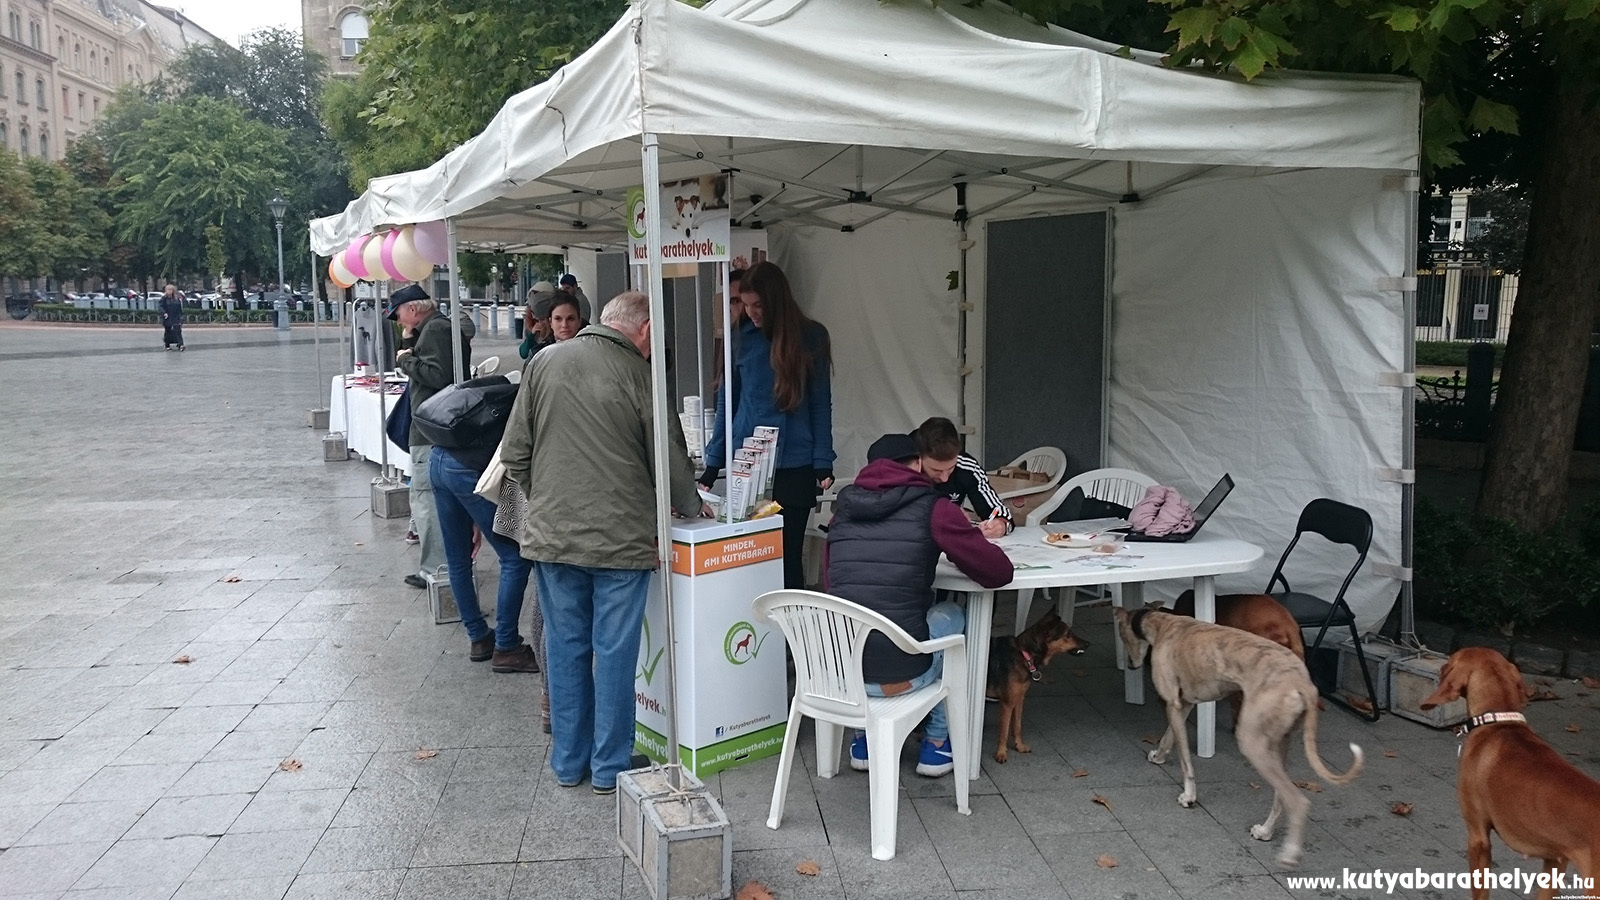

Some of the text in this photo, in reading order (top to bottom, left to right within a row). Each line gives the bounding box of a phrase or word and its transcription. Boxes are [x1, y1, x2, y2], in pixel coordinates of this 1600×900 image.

[634, 238, 725, 260] kutarathelyek.hu
[704, 545, 775, 568] AMI KUTYABARÁTI
[723, 540, 756, 553] MINDEN,
